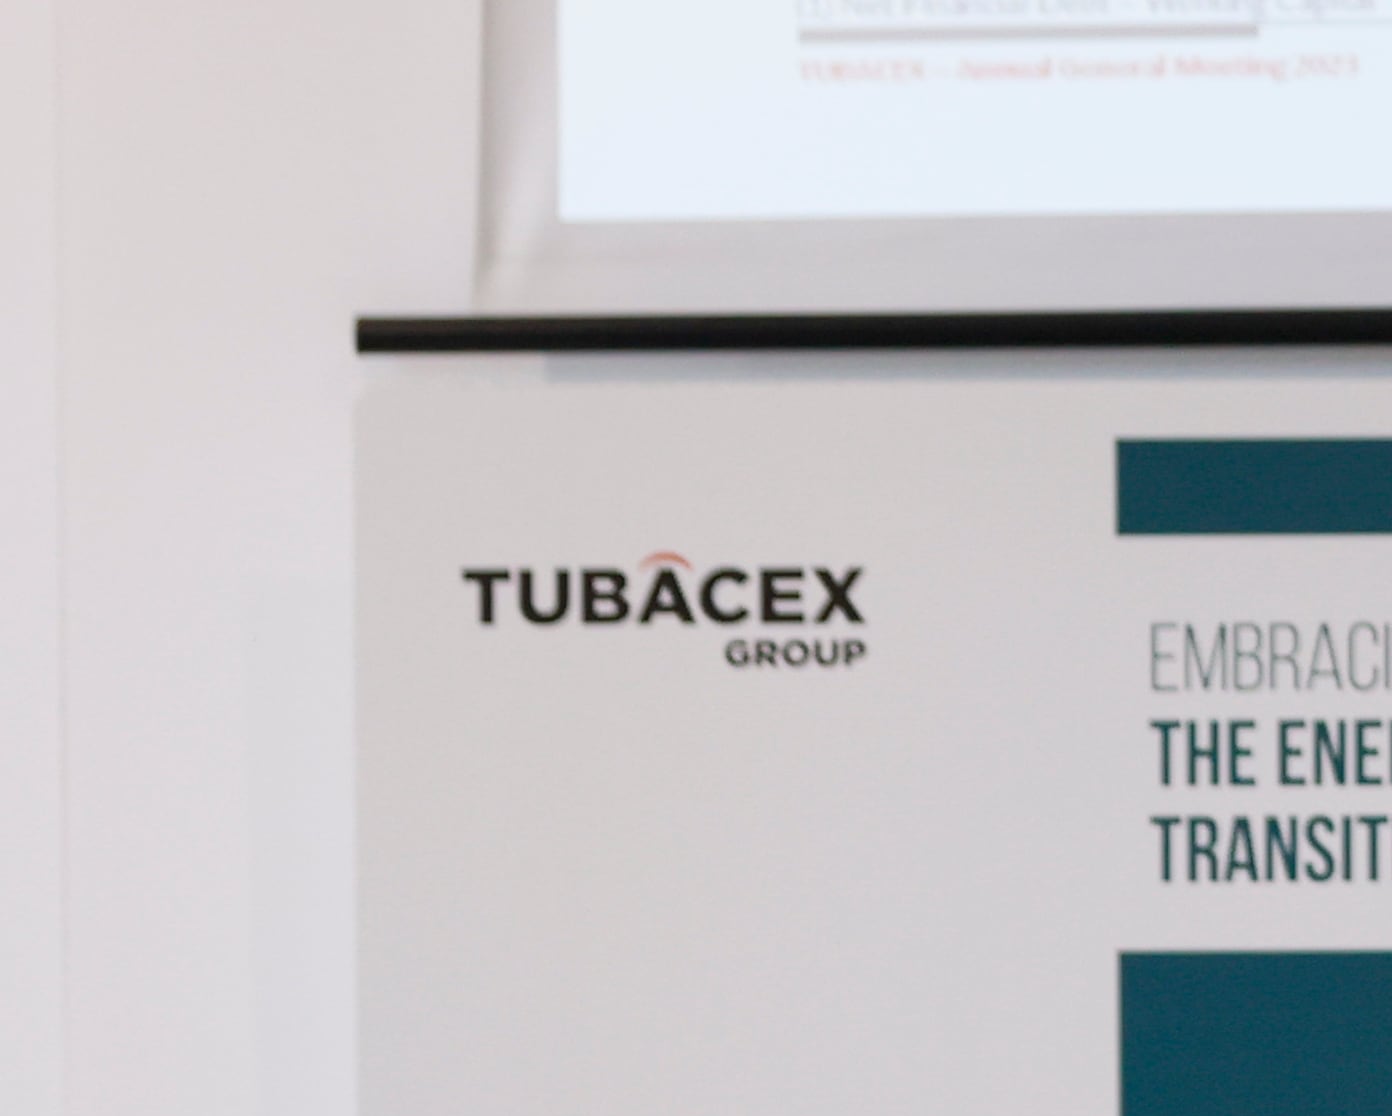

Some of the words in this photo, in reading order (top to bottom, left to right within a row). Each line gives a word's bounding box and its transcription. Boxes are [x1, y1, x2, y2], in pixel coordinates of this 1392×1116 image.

[956, 55, 1053, 79] Annual
[1057, 54, 1166, 79] General
[1174, 54, 1290, 84] Meeting
[462, 566, 865, 626] TUBACEX
[724, 639, 867, 668] GROUP
[1149, 718, 1256, 787] THE
